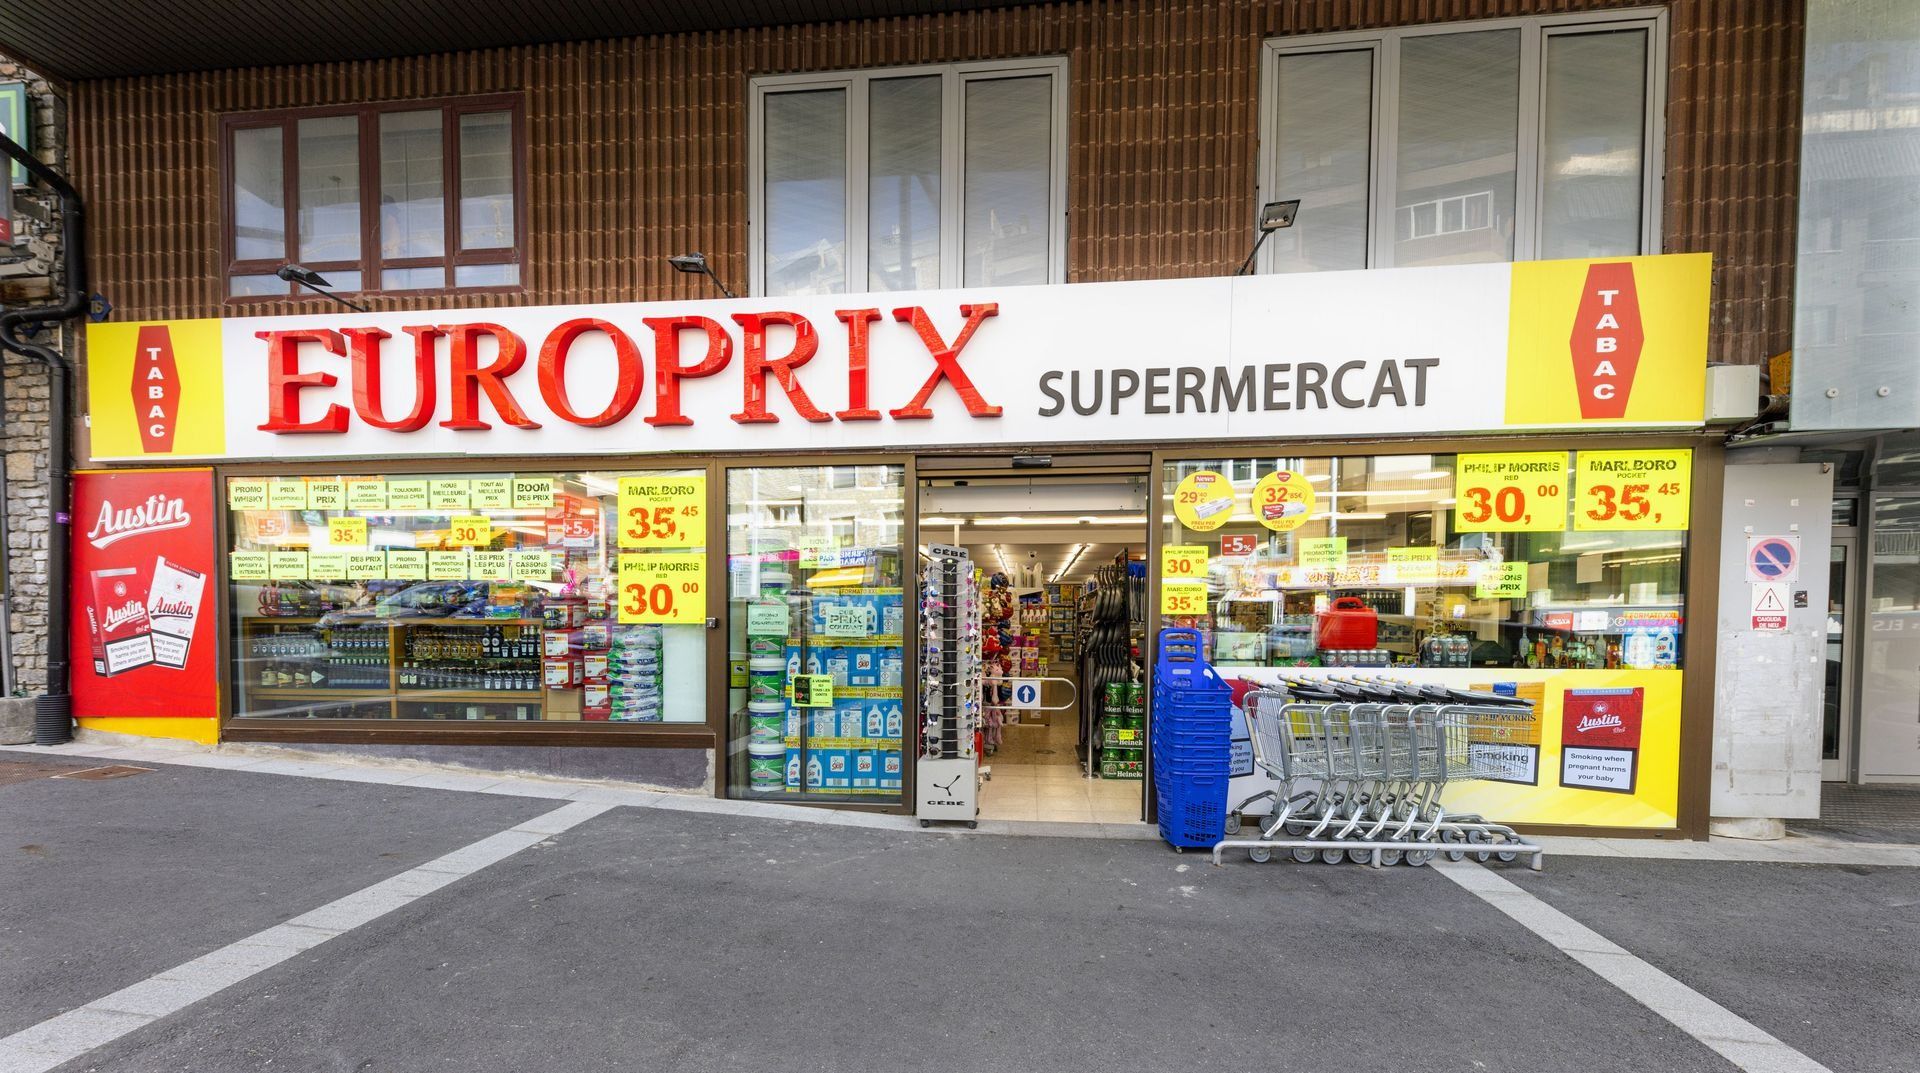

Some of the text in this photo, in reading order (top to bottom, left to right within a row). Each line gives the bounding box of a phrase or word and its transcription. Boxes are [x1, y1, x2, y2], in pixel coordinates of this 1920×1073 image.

[1593, 290, 1620, 400] TABAC
[254, 302, 1003, 435] EUROPRIX
[146, 347, 166, 438] TABAC
[1038, 357, 1440, 417] SUPERMERCAT
[1464, 462, 1560, 473] PHILIP MORRIS
[1590, 460, 1677, 472] MARLBORO
[313, 484, 339, 492] HIPER
[517, 484, 550, 492] BOOM
[628, 486, 695, 496] MARLBORO
[1537, 485, 1559, 497] 00
[1658, 483, 1680, 495] 45
[316, 496, 336, 504] PRIX
[1179, 492, 1198, 504] 29
[1265, 487, 1288, 503] 32
[681, 506, 698, 517] 45
[87, 494, 191, 546] Austin
[1224, 537, 1252, 552] -5%
[932, 548, 967, 559] CÉBÉ
[624, 562, 699, 571] PHILIP MORRIS
[682, 583, 699, 593] 00
[150, 596, 193, 619] Austin
[103, 600, 145, 631] Austin
[830, 615, 862, 624] PRIX
[1576, 714, 1622, 732] Austin
[1475, 749, 1529, 764] Smoking
[1570, 753, 1602, 761] Smoking
[1602, 764, 1626, 772] harms
[1596, 774, 1614, 782] baby
